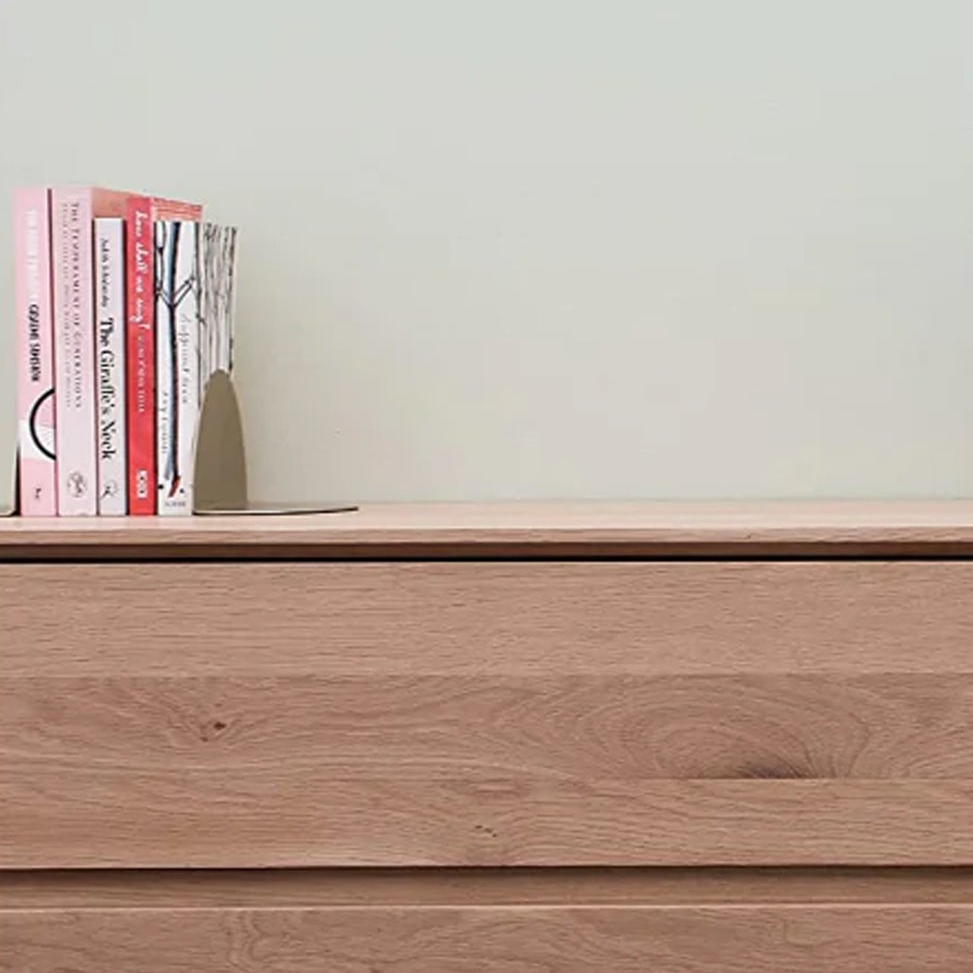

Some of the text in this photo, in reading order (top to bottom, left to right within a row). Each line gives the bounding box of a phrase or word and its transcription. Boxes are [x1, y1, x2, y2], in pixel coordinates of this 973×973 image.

[99, 316, 118, 460] The Giraffe's Neck
